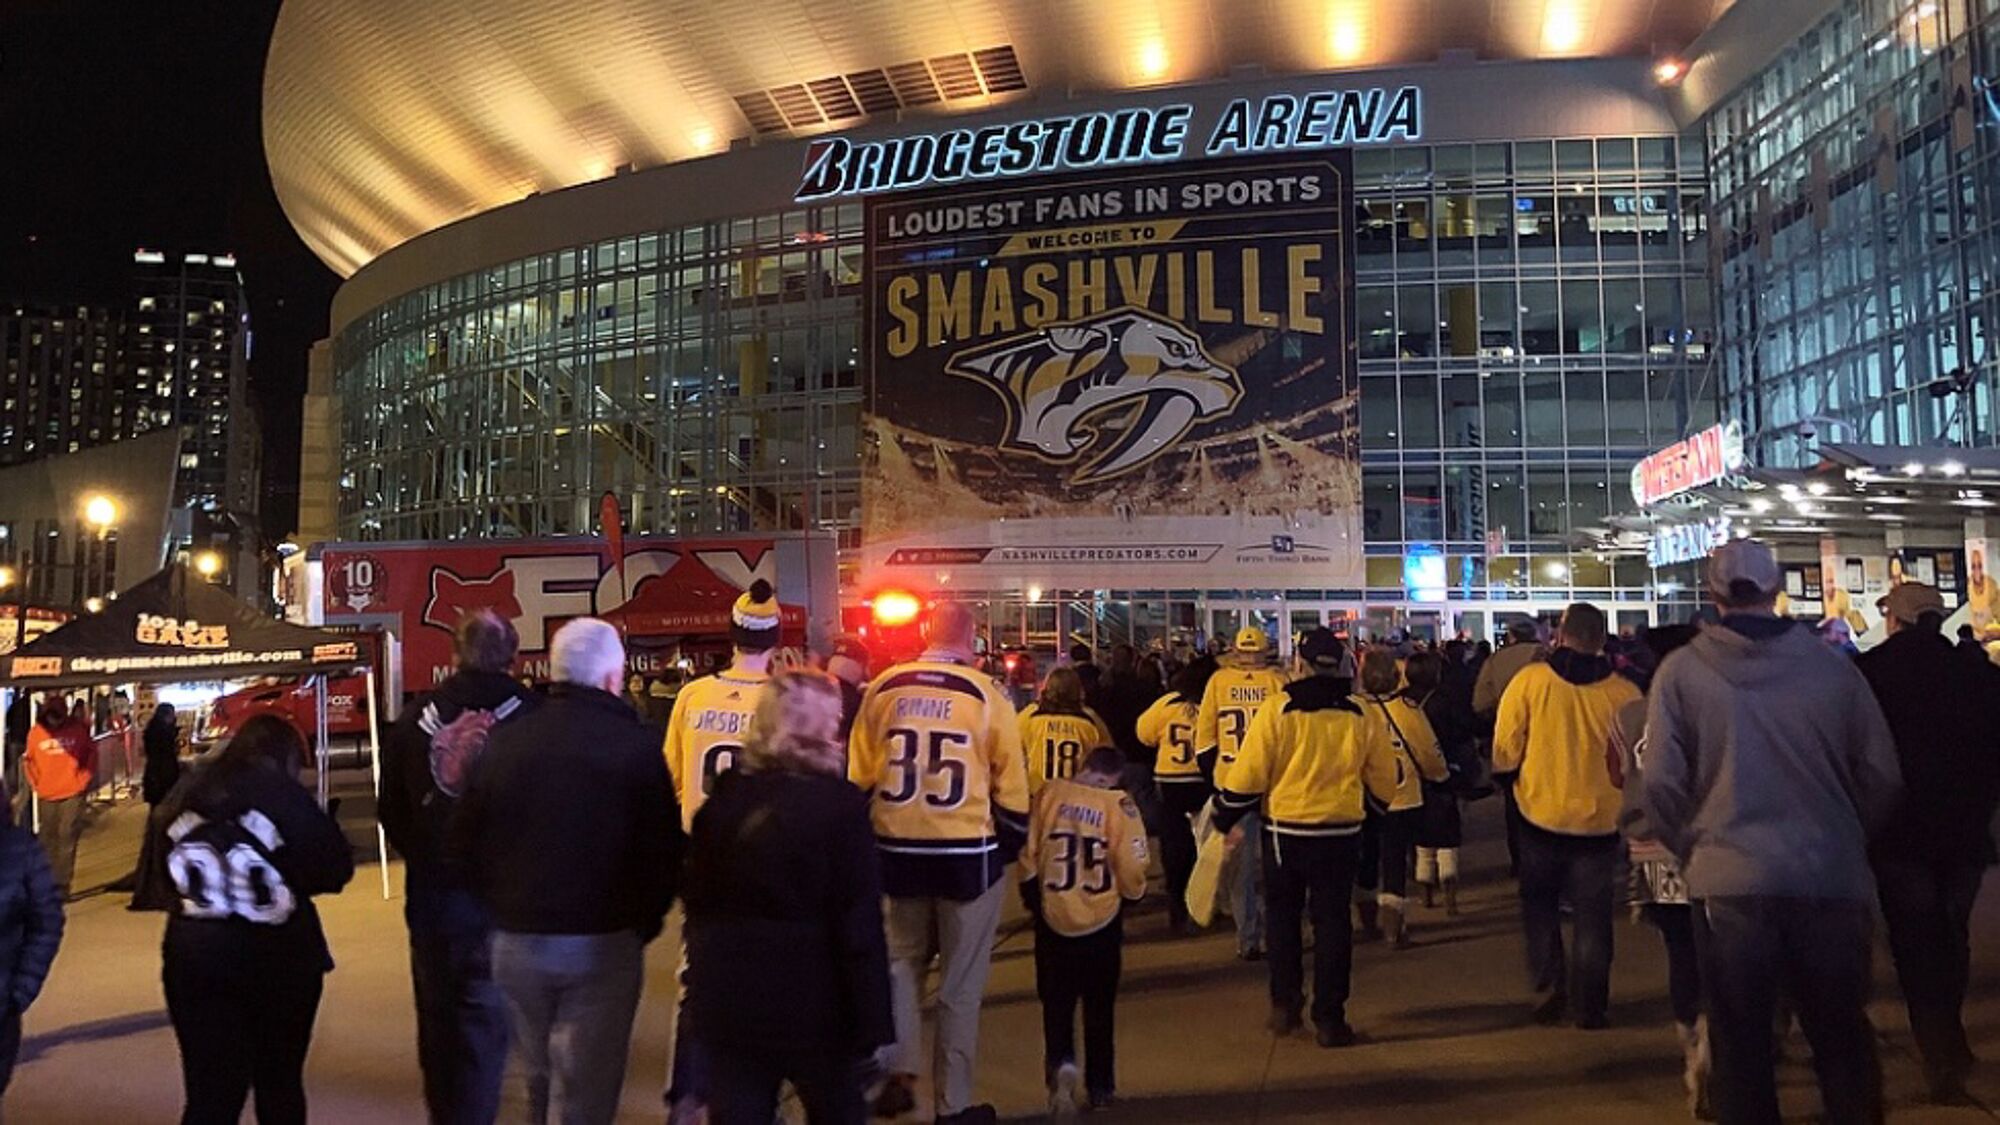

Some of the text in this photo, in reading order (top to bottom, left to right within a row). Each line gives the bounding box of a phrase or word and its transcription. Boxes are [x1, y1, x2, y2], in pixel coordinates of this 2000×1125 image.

[793, 86, 1421, 202] BRIDGESTONE ARENA
[888, 175, 1322, 239] LOUDEST FANS IN SPORTS
[1026, 227, 1155, 249] WELCOME TO
[886, 243, 1325, 358] SMASHVILLE
[1001, 549, 1199, 560] NASHVILLEPREDATORS.COM
[342, 561, 373, 588] 10
[136, 622, 230, 648] GAME
[1230, 687, 1268, 702] RINNE
[895, 697, 953, 720] RINNE
[879, 726, 971, 811] 35
[1043, 737, 1082, 781] 18
[1057, 803, 1105, 829] RINNE
[1045, 830, 1116, 895] 35
